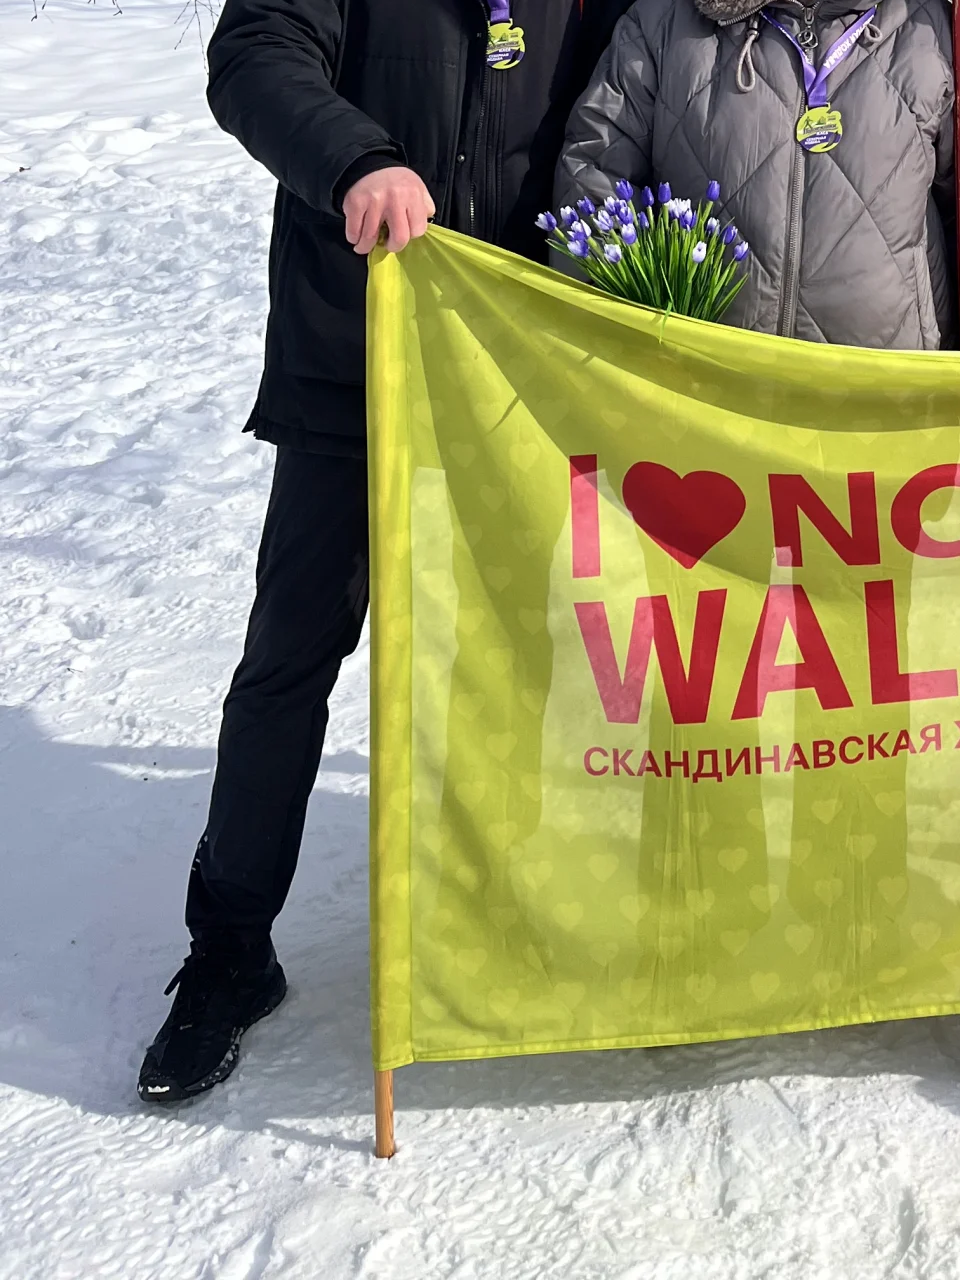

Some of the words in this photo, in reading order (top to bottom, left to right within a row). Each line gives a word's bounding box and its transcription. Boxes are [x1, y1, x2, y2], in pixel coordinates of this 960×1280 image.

[822, 38, 852, 69] ХОДЬБА
[568, 453, 601, 579] I
[583, 723, 942, 783] СКАНДИНАВСКАЯ
